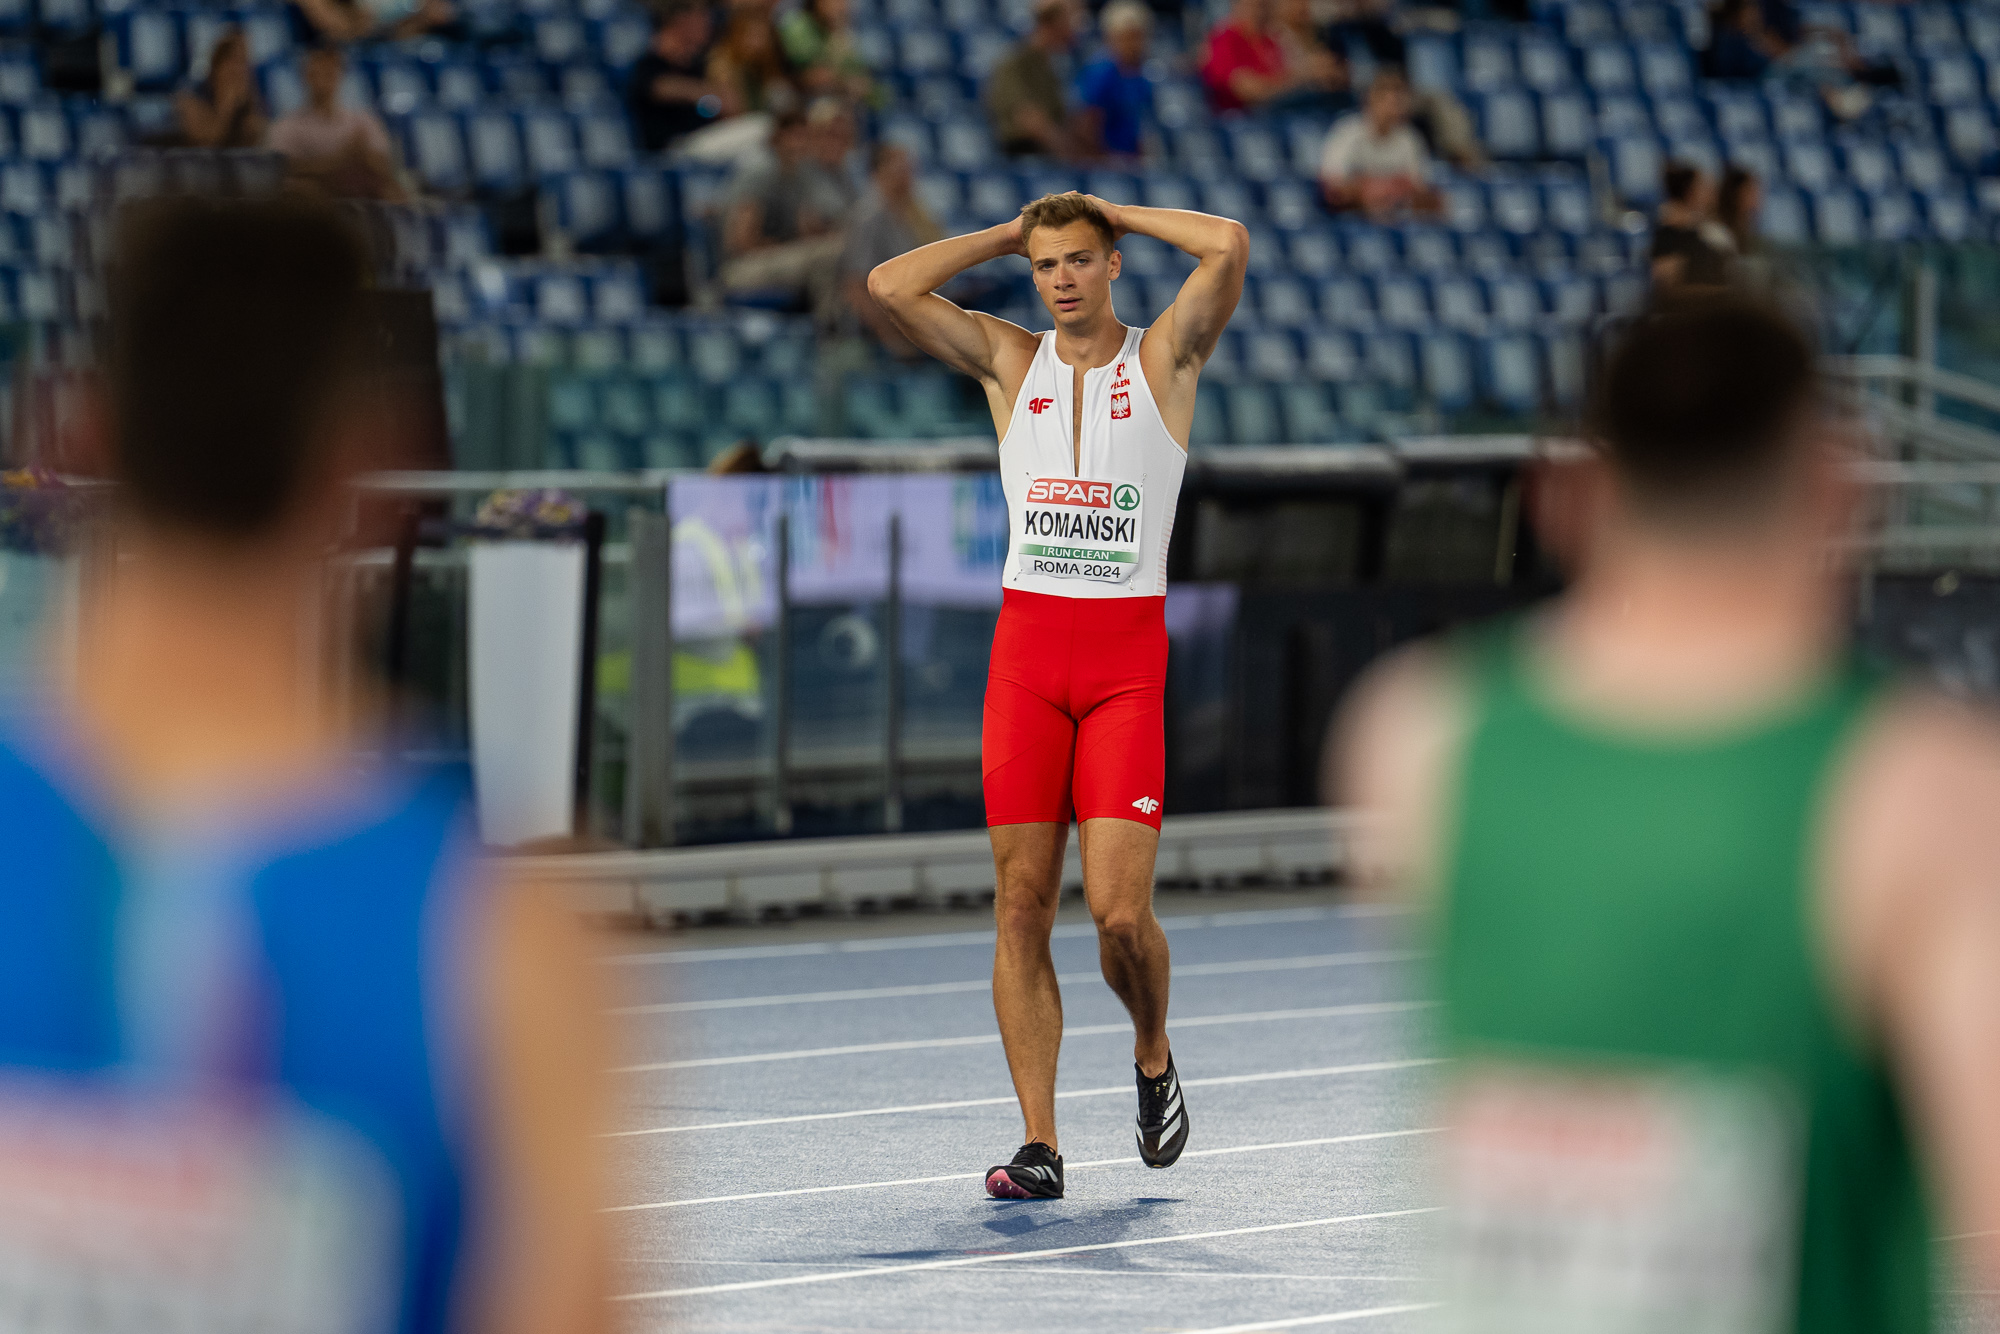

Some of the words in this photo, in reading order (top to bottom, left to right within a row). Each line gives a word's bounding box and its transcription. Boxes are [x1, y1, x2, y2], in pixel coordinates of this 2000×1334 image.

[1029, 481, 1109, 505] SPAR
[1025, 510, 1135, 543] KOMAŃSKI
[1042, 547, 1046, 555] I
[1047, 547, 1070, 557] RUN
[1034, 560, 1080, 574] ROMA
[1084, 564, 1120, 578] 2024
[1132, 796, 1159, 815] 4F
